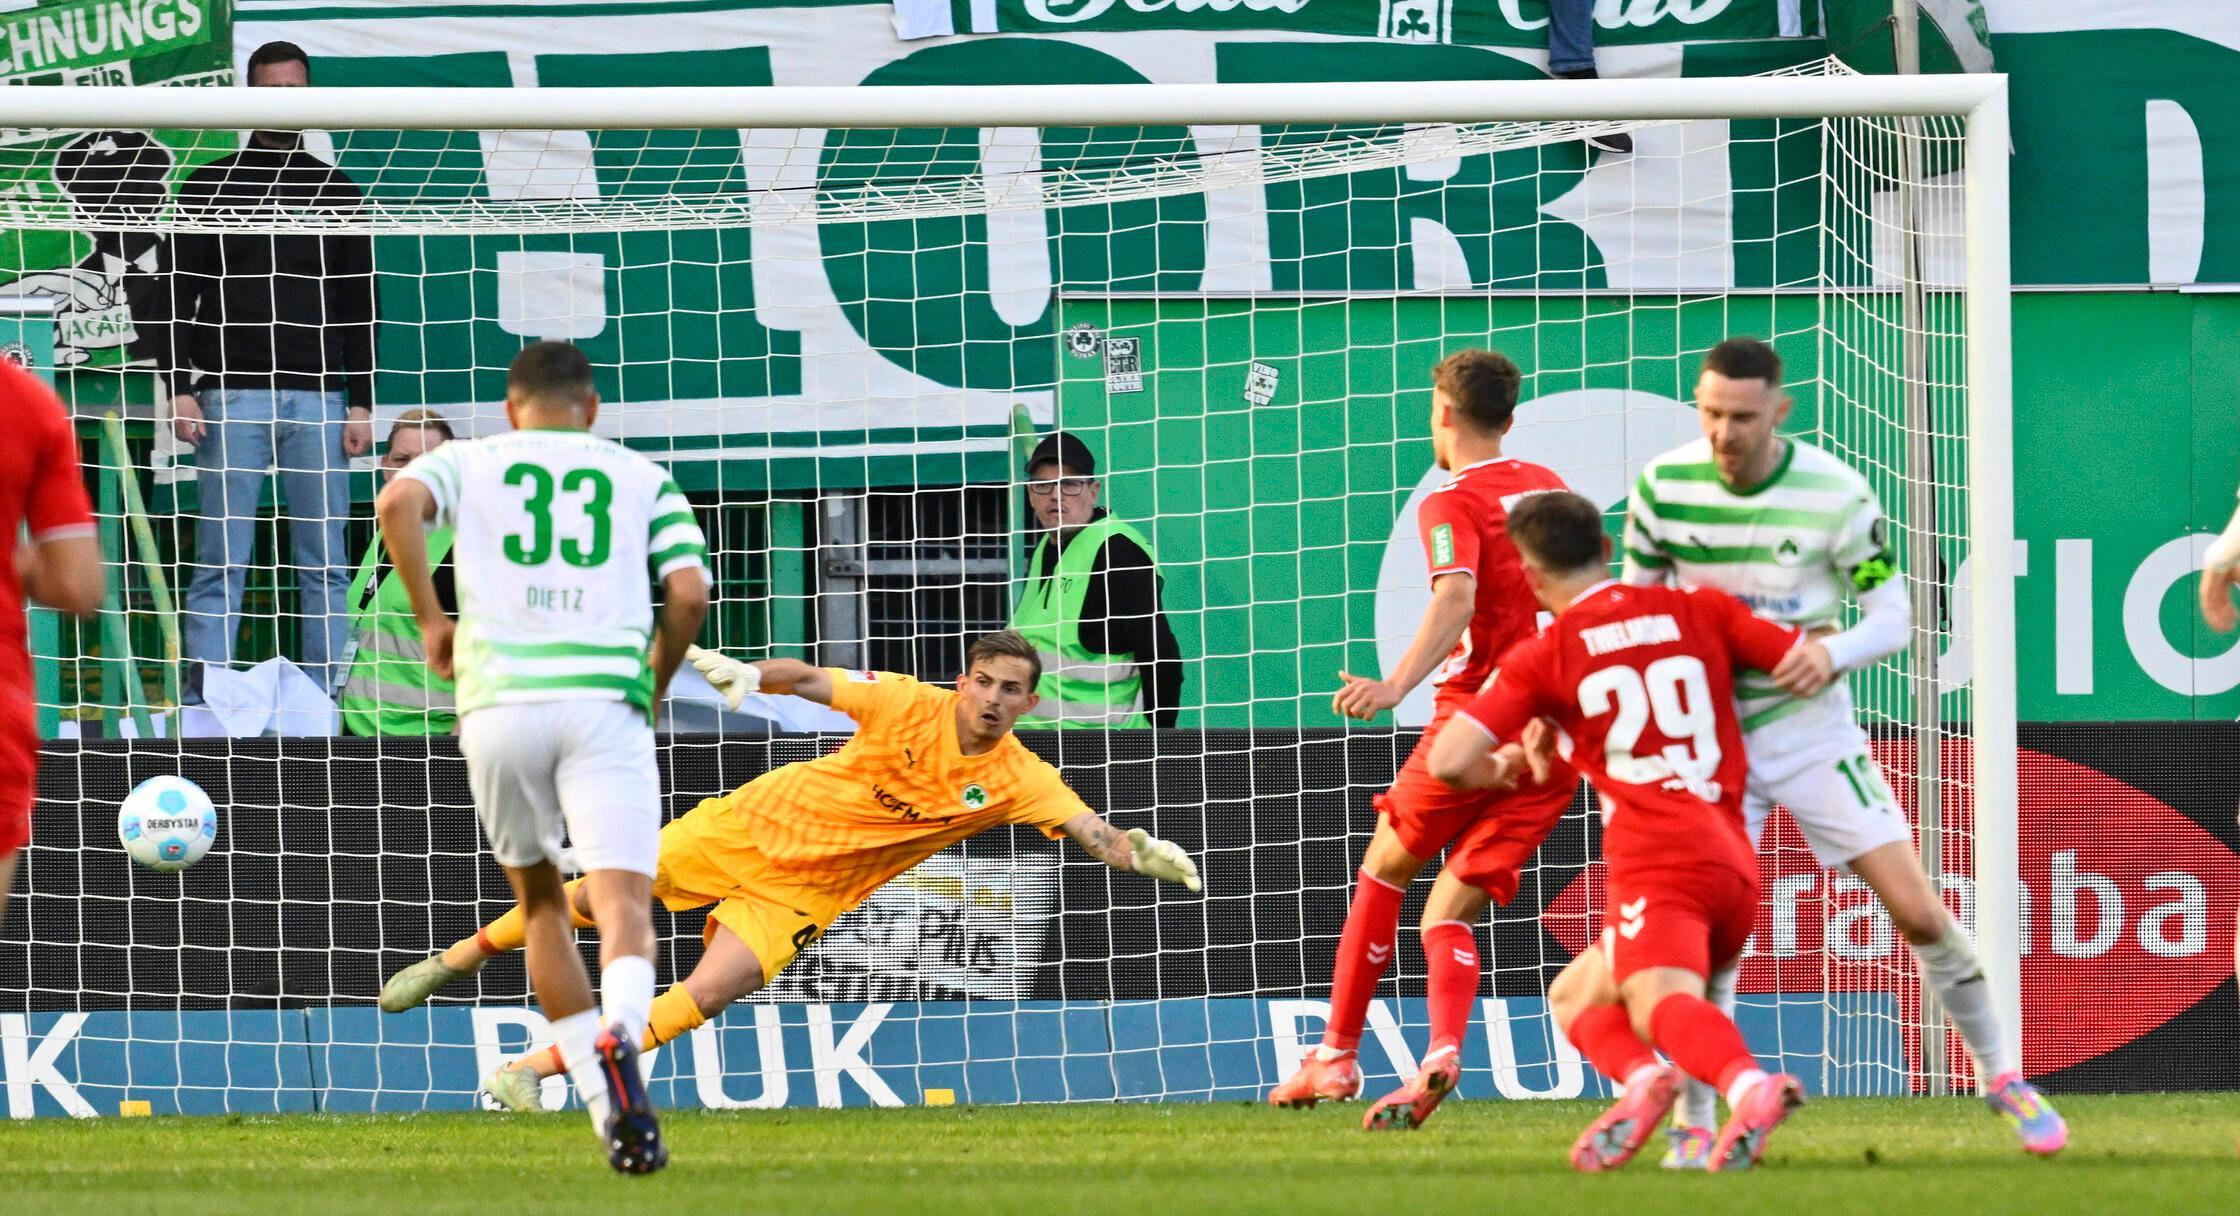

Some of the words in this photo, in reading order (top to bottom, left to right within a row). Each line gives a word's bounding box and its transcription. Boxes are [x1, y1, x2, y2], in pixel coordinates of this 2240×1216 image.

[0, 0, 205, 73] HNUNGS
[503, 462, 613, 568] 33
[1435, 527, 1451, 565] DEVK
[527, 586, 584, 612] DIETZ
[1577, 655, 1722, 785] 29
